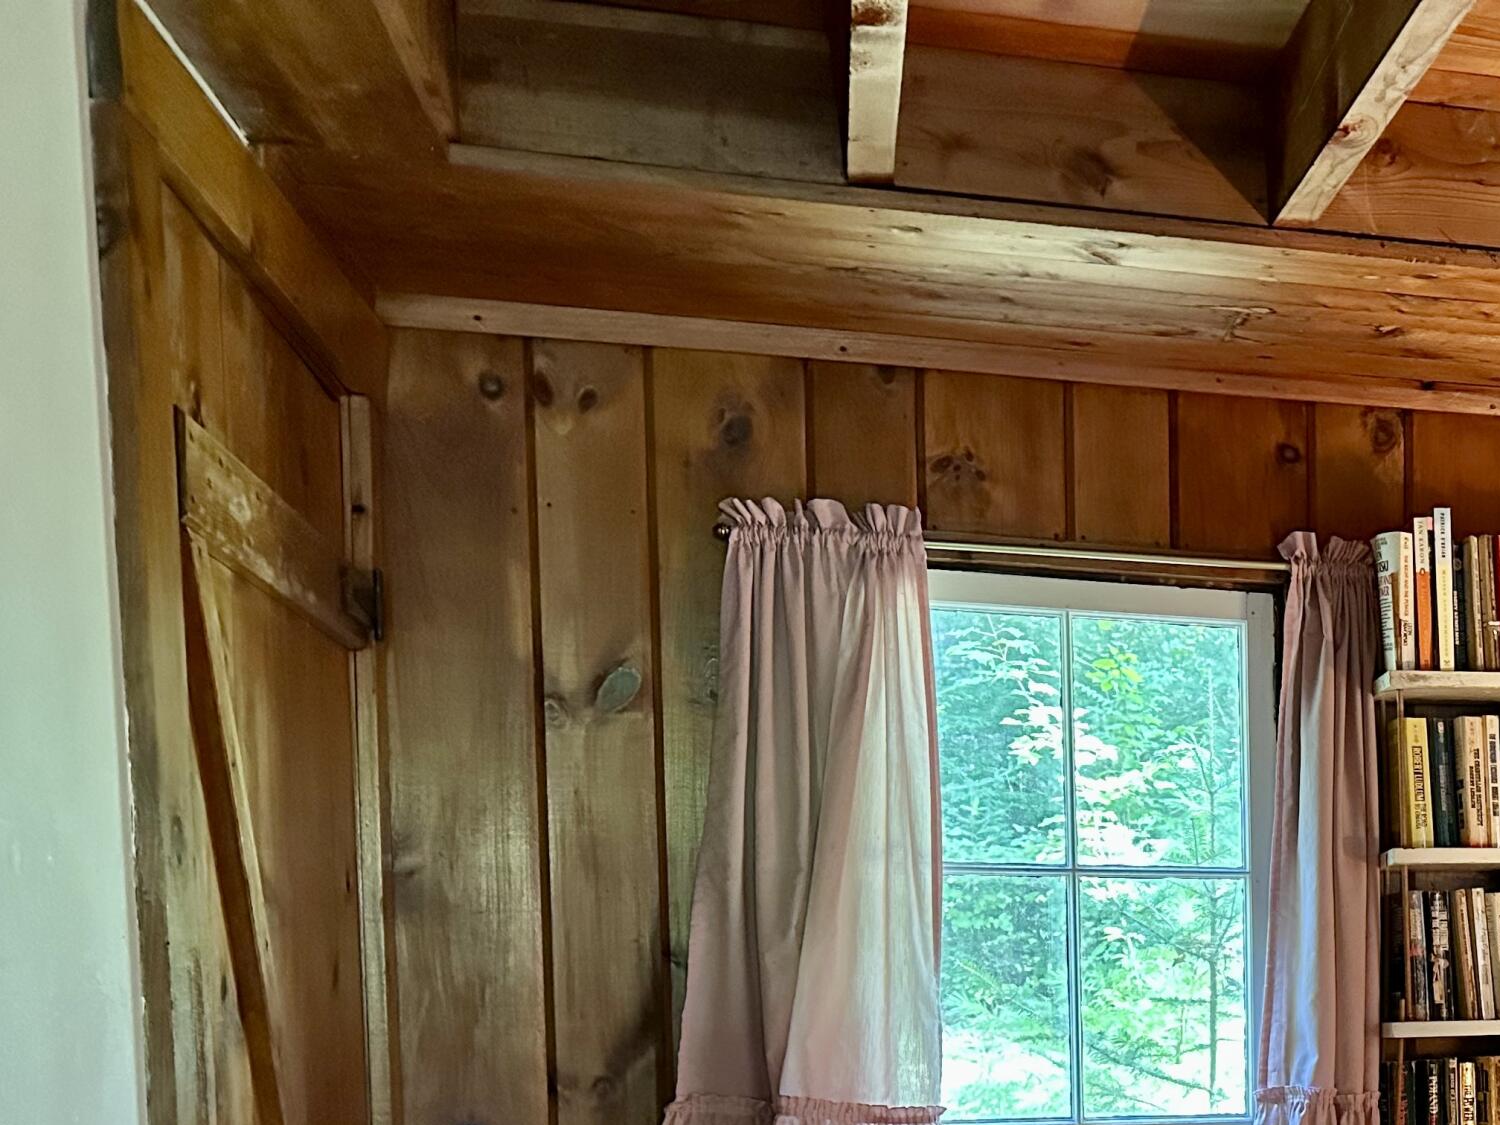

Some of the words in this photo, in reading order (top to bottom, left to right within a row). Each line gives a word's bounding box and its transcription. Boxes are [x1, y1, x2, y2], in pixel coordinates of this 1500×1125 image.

[1412, 747, 1422, 773] ROBERT
[1414, 774, 1425, 802] LUDLUM
[1429, 1075, 1439, 1114] POLAND
[1464, 1084, 1472, 1097] THE
[1463, 1097, 1475, 1121] POWER
